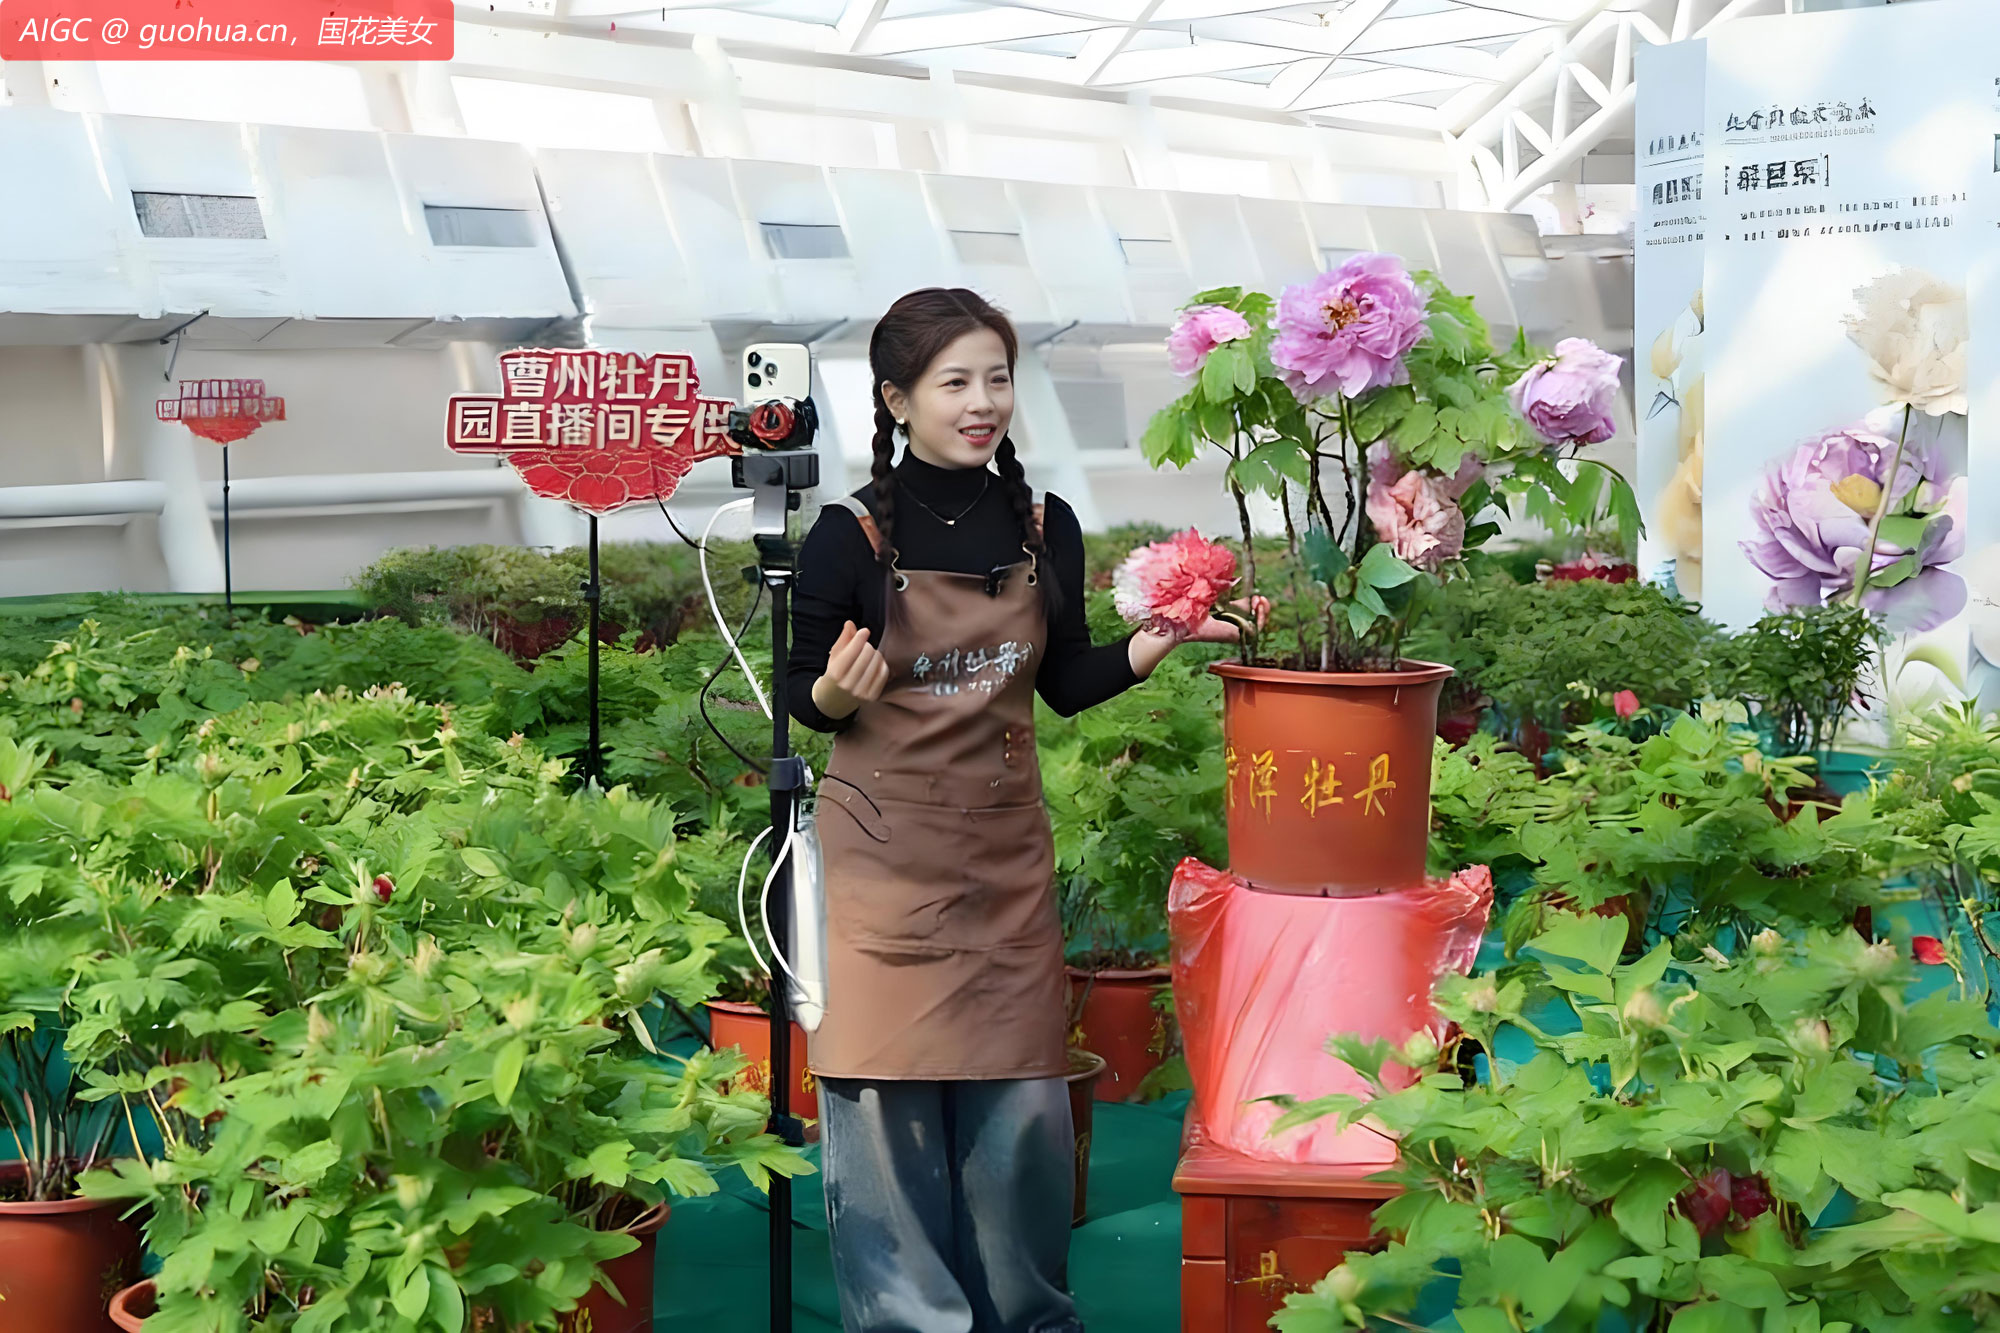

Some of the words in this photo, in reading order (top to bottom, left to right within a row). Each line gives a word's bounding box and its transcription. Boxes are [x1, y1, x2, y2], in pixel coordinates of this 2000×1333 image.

[502, 354, 690, 401] 曹州牡丹
[453, 401, 741, 450] 园直播间专供
